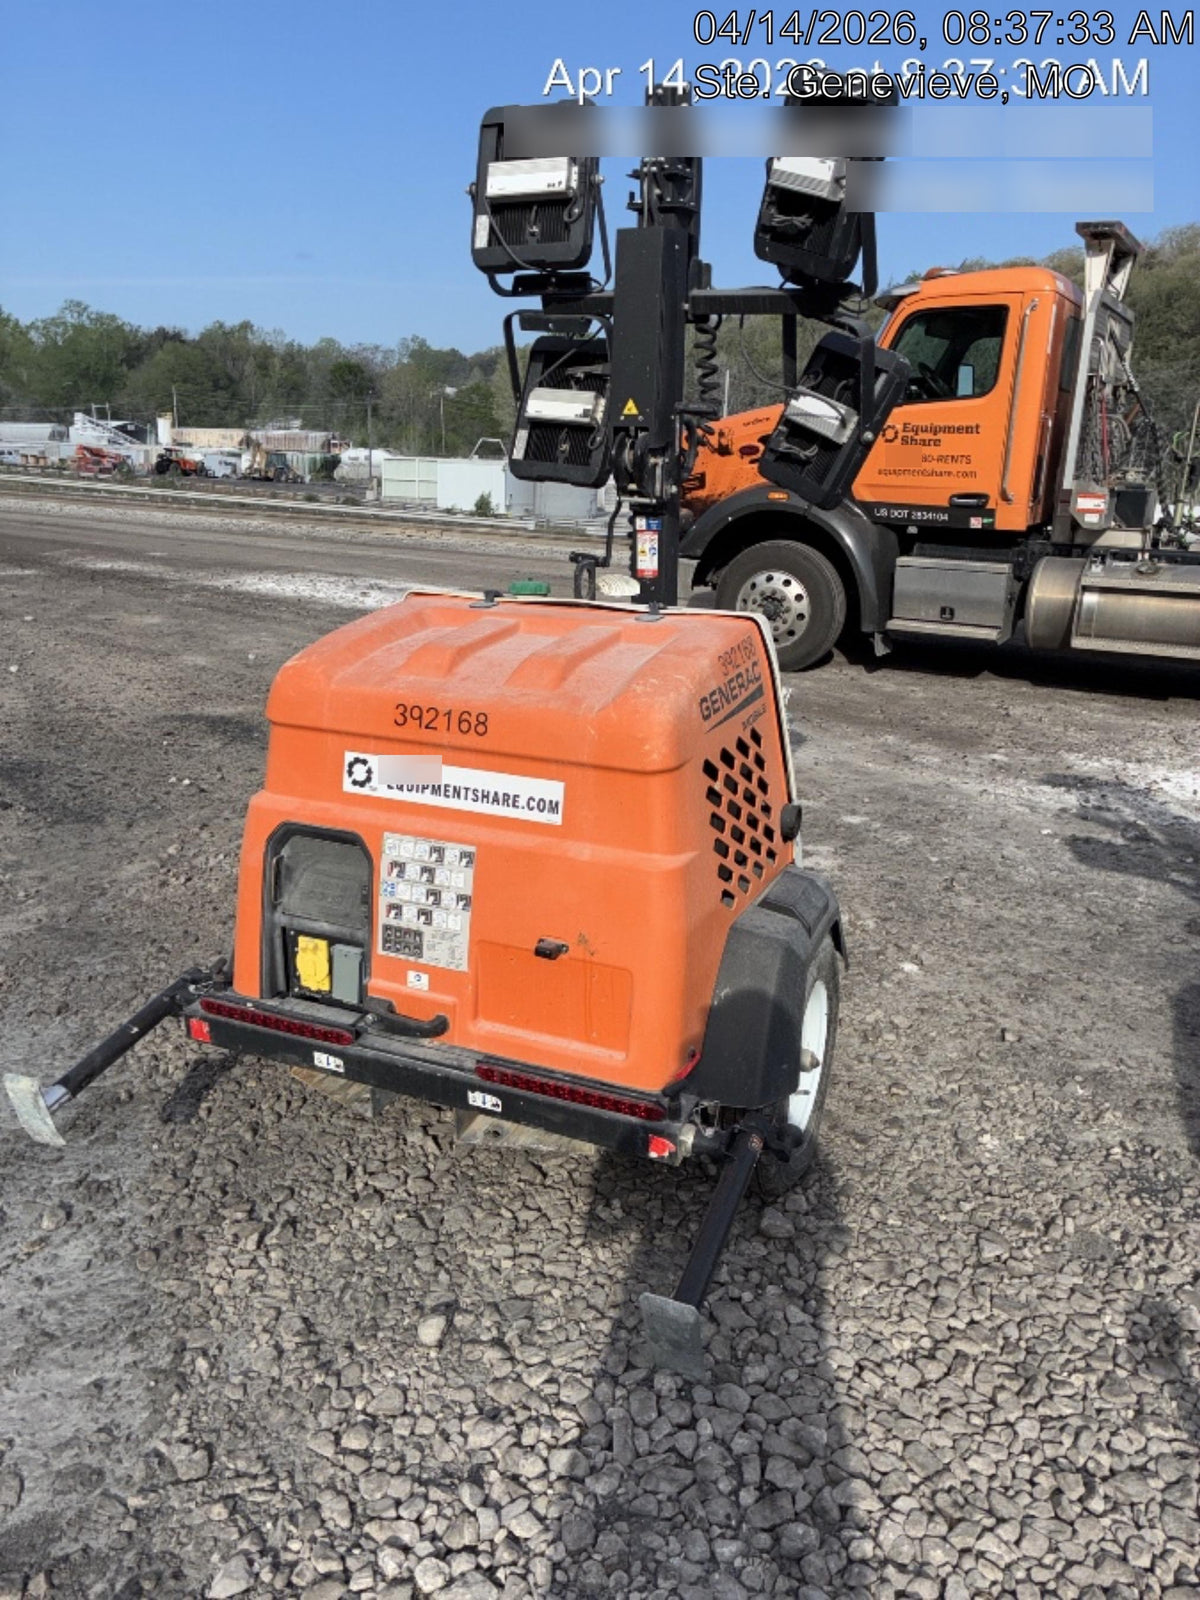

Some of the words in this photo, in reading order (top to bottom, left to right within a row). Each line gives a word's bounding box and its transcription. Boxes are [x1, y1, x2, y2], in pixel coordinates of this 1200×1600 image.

[902, 422, 981, 436] Equipment
[900, 435, 942, 447] Share
[890, 509, 909, 519] DOT
[699, 659, 762, 722] GENERAC
[394, 703, 488, 737] 392168
